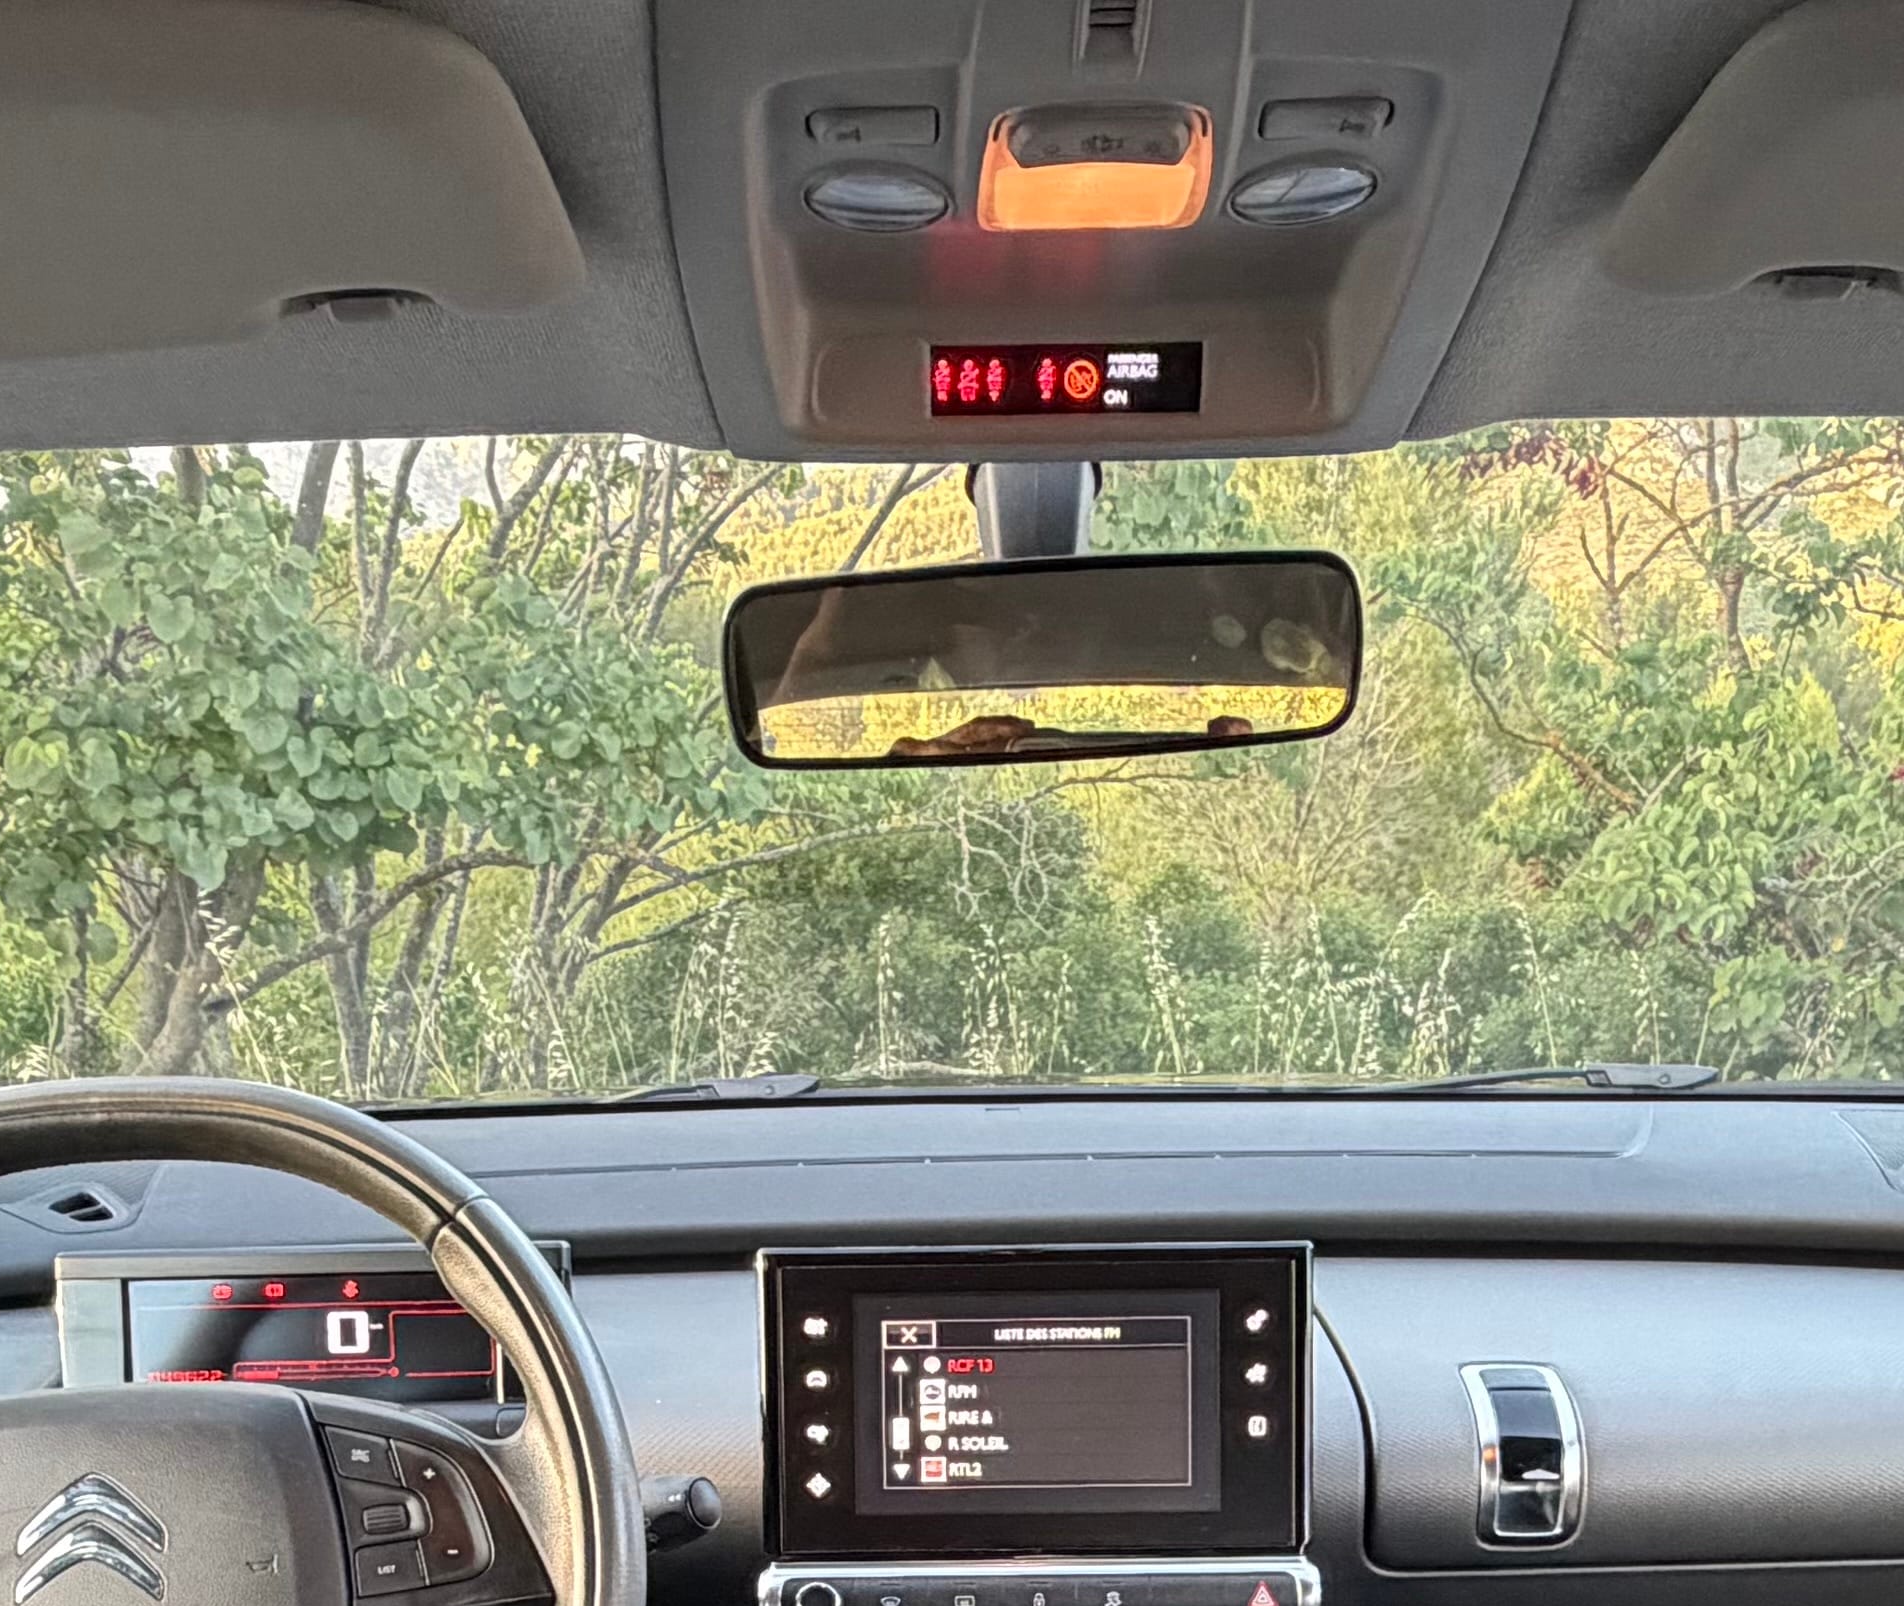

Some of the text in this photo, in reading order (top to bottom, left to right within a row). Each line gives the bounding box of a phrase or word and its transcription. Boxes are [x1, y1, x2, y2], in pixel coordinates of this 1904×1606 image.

[1106, 363, 1158, 379] AIRBAG
[1103, 389, 1128, 405] ON
[994, 1328, 1024, 1341] LISTE
[1025, 1327, 1048, 1340] DES
[1049, 1327, 1102, 1340] STATIONS
[948, 1358, 993, 1372] RCF 13
[948, 1436, 959, 1451] R
[949, 1461, 983, 1477] RTL2
